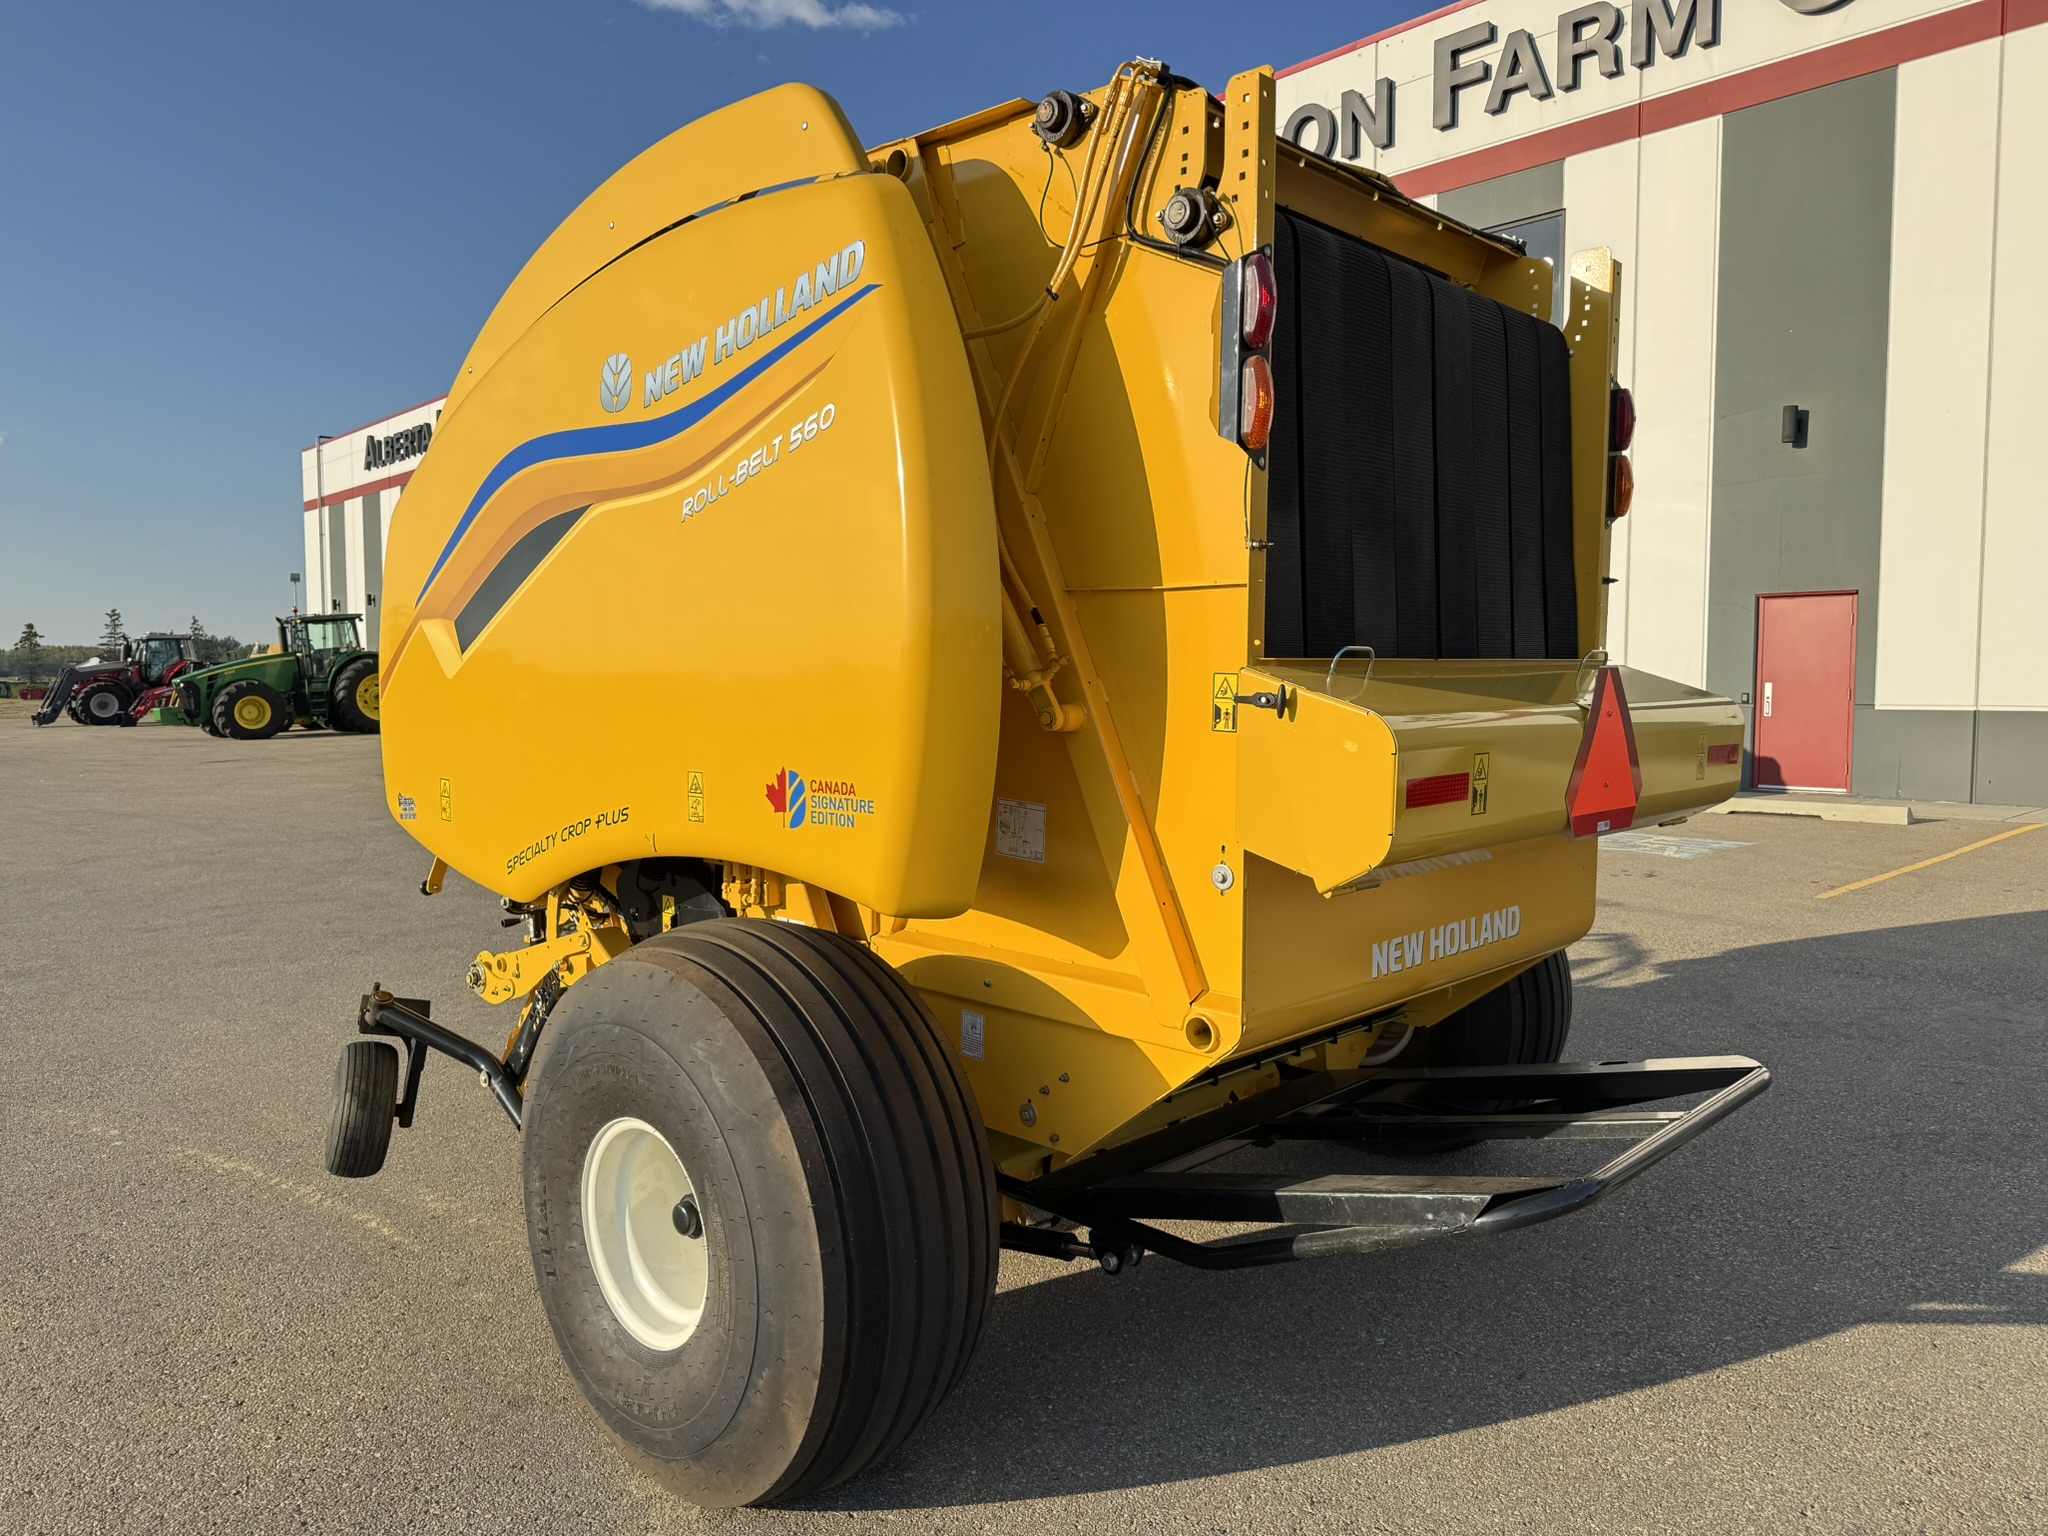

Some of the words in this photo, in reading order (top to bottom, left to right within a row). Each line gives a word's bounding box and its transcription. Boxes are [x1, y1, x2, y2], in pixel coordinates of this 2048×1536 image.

[1433, 0, 1721, 132] FARM
[643, 336, 707, 408] NEW
[714, 239, 866, 365] HOLLAND
[364, 423, 432, 471] ALBERTA
[681, 434, 783, 523] ROLL-BELT
[789, 402, 836, 453] 560
[810, 779, 856, 797] CANADA
[810, 795, 875, 815] SIGNATURE
[810, 811, 856, 828] EDITION
[506, 831, 558, 875] SPECIALTY
[560, 818, 592, 843] CROP
[595, 807, 630, 829] PLUS
[1371, 930, 1425, 979] NEW
[1429, 905, 1521, 962] HOLLAND
